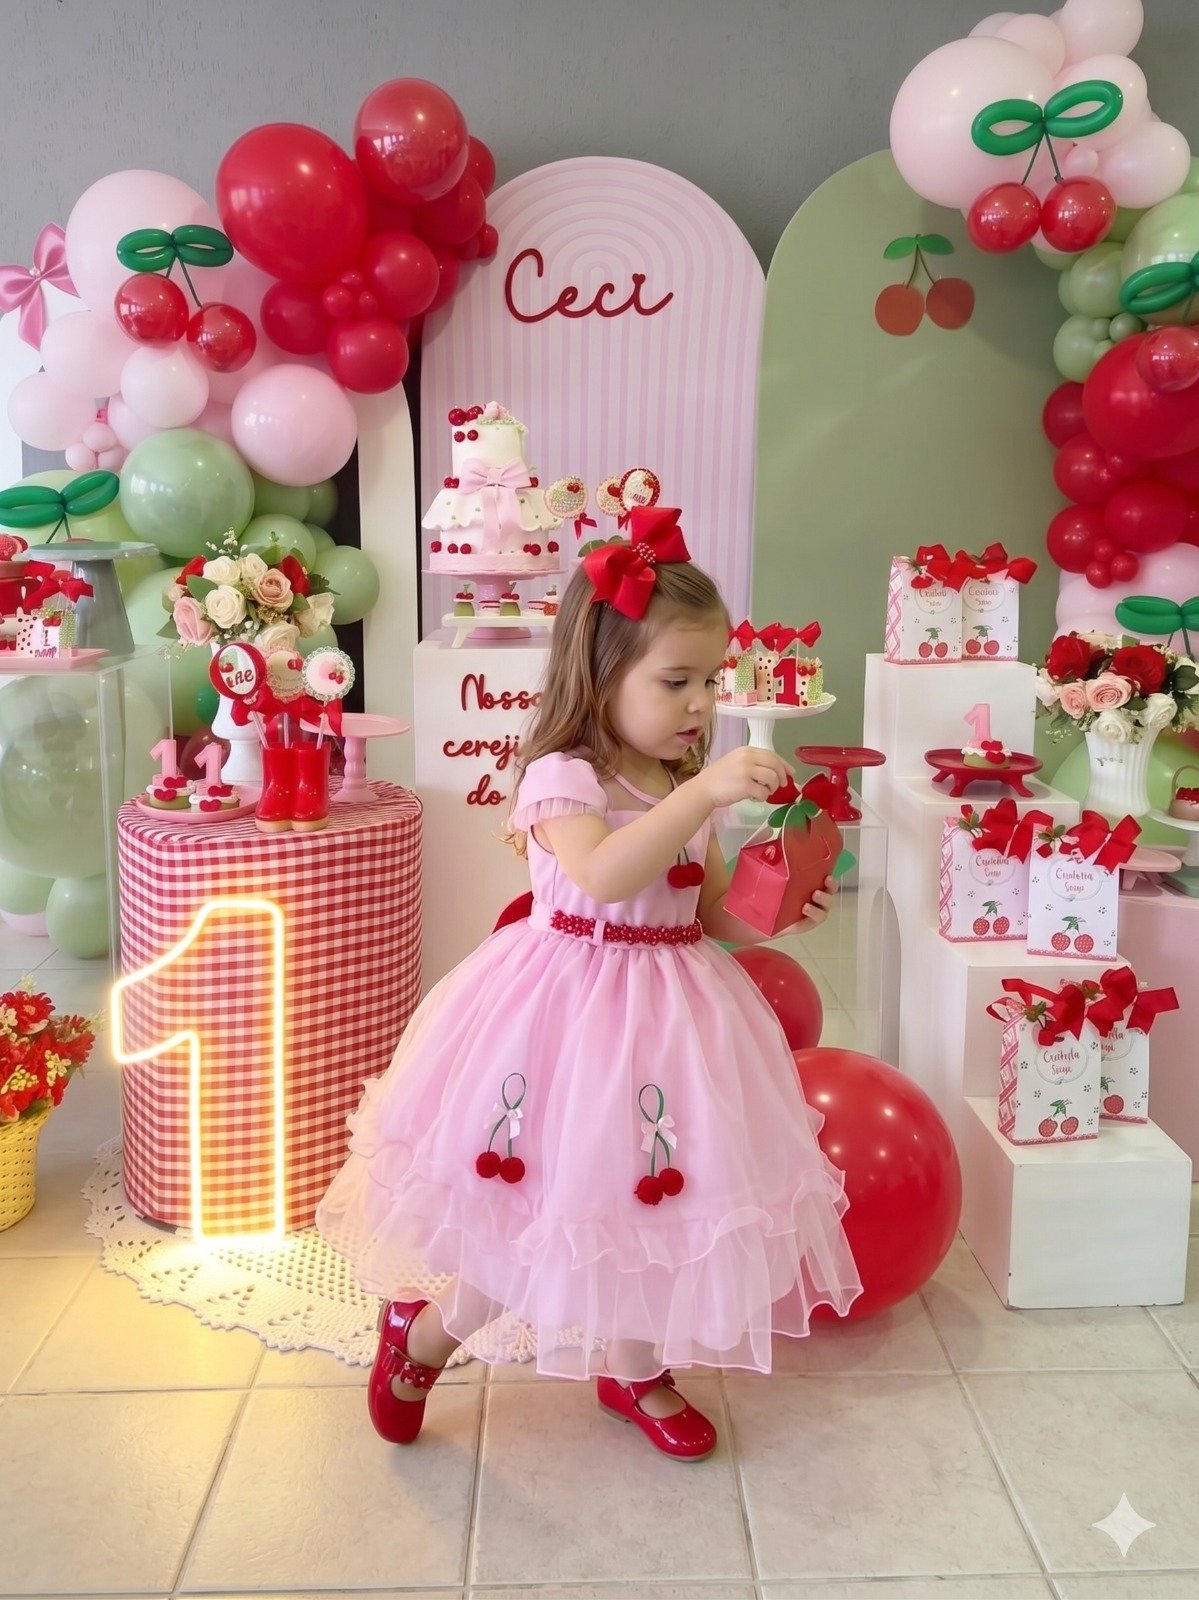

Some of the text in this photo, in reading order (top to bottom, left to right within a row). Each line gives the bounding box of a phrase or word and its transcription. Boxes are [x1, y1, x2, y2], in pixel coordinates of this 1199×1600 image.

[505, 248, 674, 323] Ceci
[773, 657, 800, 706] 1
[466, 774, 507, 806] do
[110, 898, 286, 1244] 1
